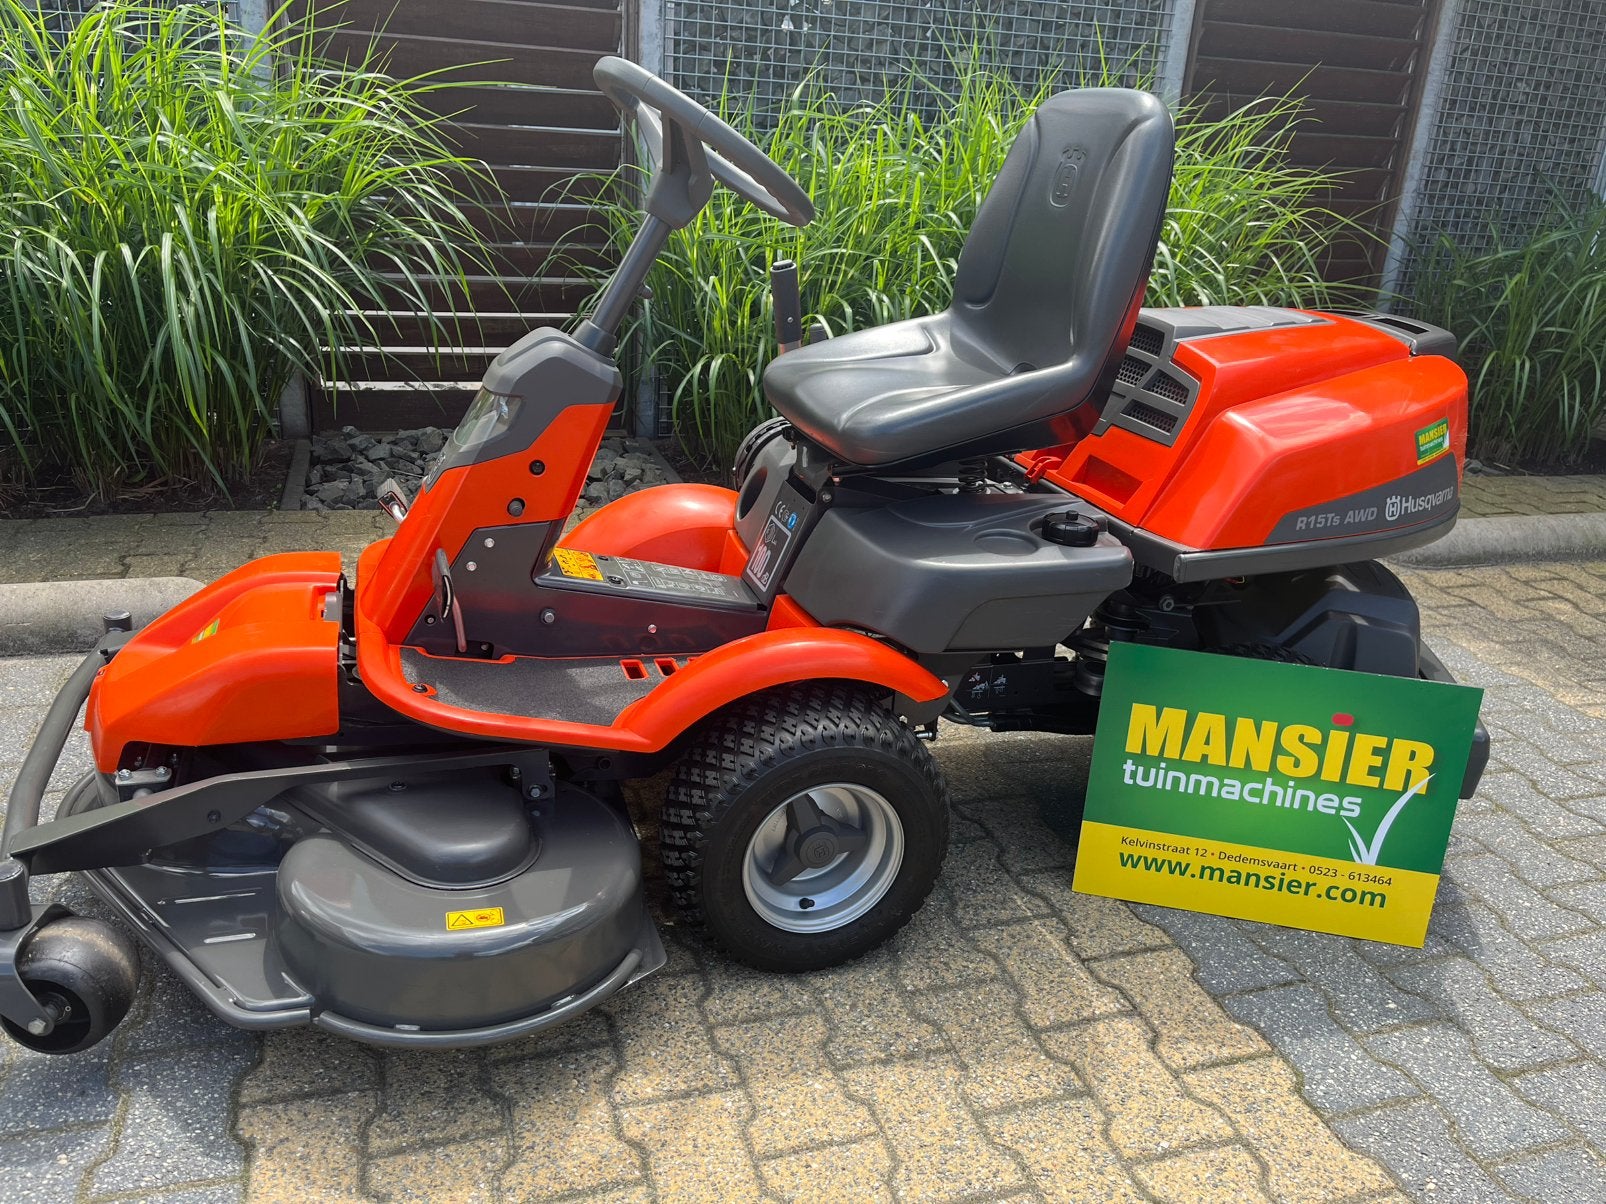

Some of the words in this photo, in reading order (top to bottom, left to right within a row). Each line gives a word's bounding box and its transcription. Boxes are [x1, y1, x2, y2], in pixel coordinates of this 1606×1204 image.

[1296, 513, 1340, 531] R15Ts
[1344, 508, 1377, 525] AWD
[1401, 486, 1453, 515] Husqvarna
[1125, 702, 1435, 795] MANSIER
[1123, 759, 1362, 818] tuinmachines
[1119, 852, 1388, 908] www.mansier.com
[1121, 836, 1190, 855] Kelvinstraat
[1194, 848, 1208, 858] 12
[1218, 851, 1298, 871] Dedemsvaart
[1309, 865, 1338, 878] 0523
[1348, 871, 1393, 886] 613464
